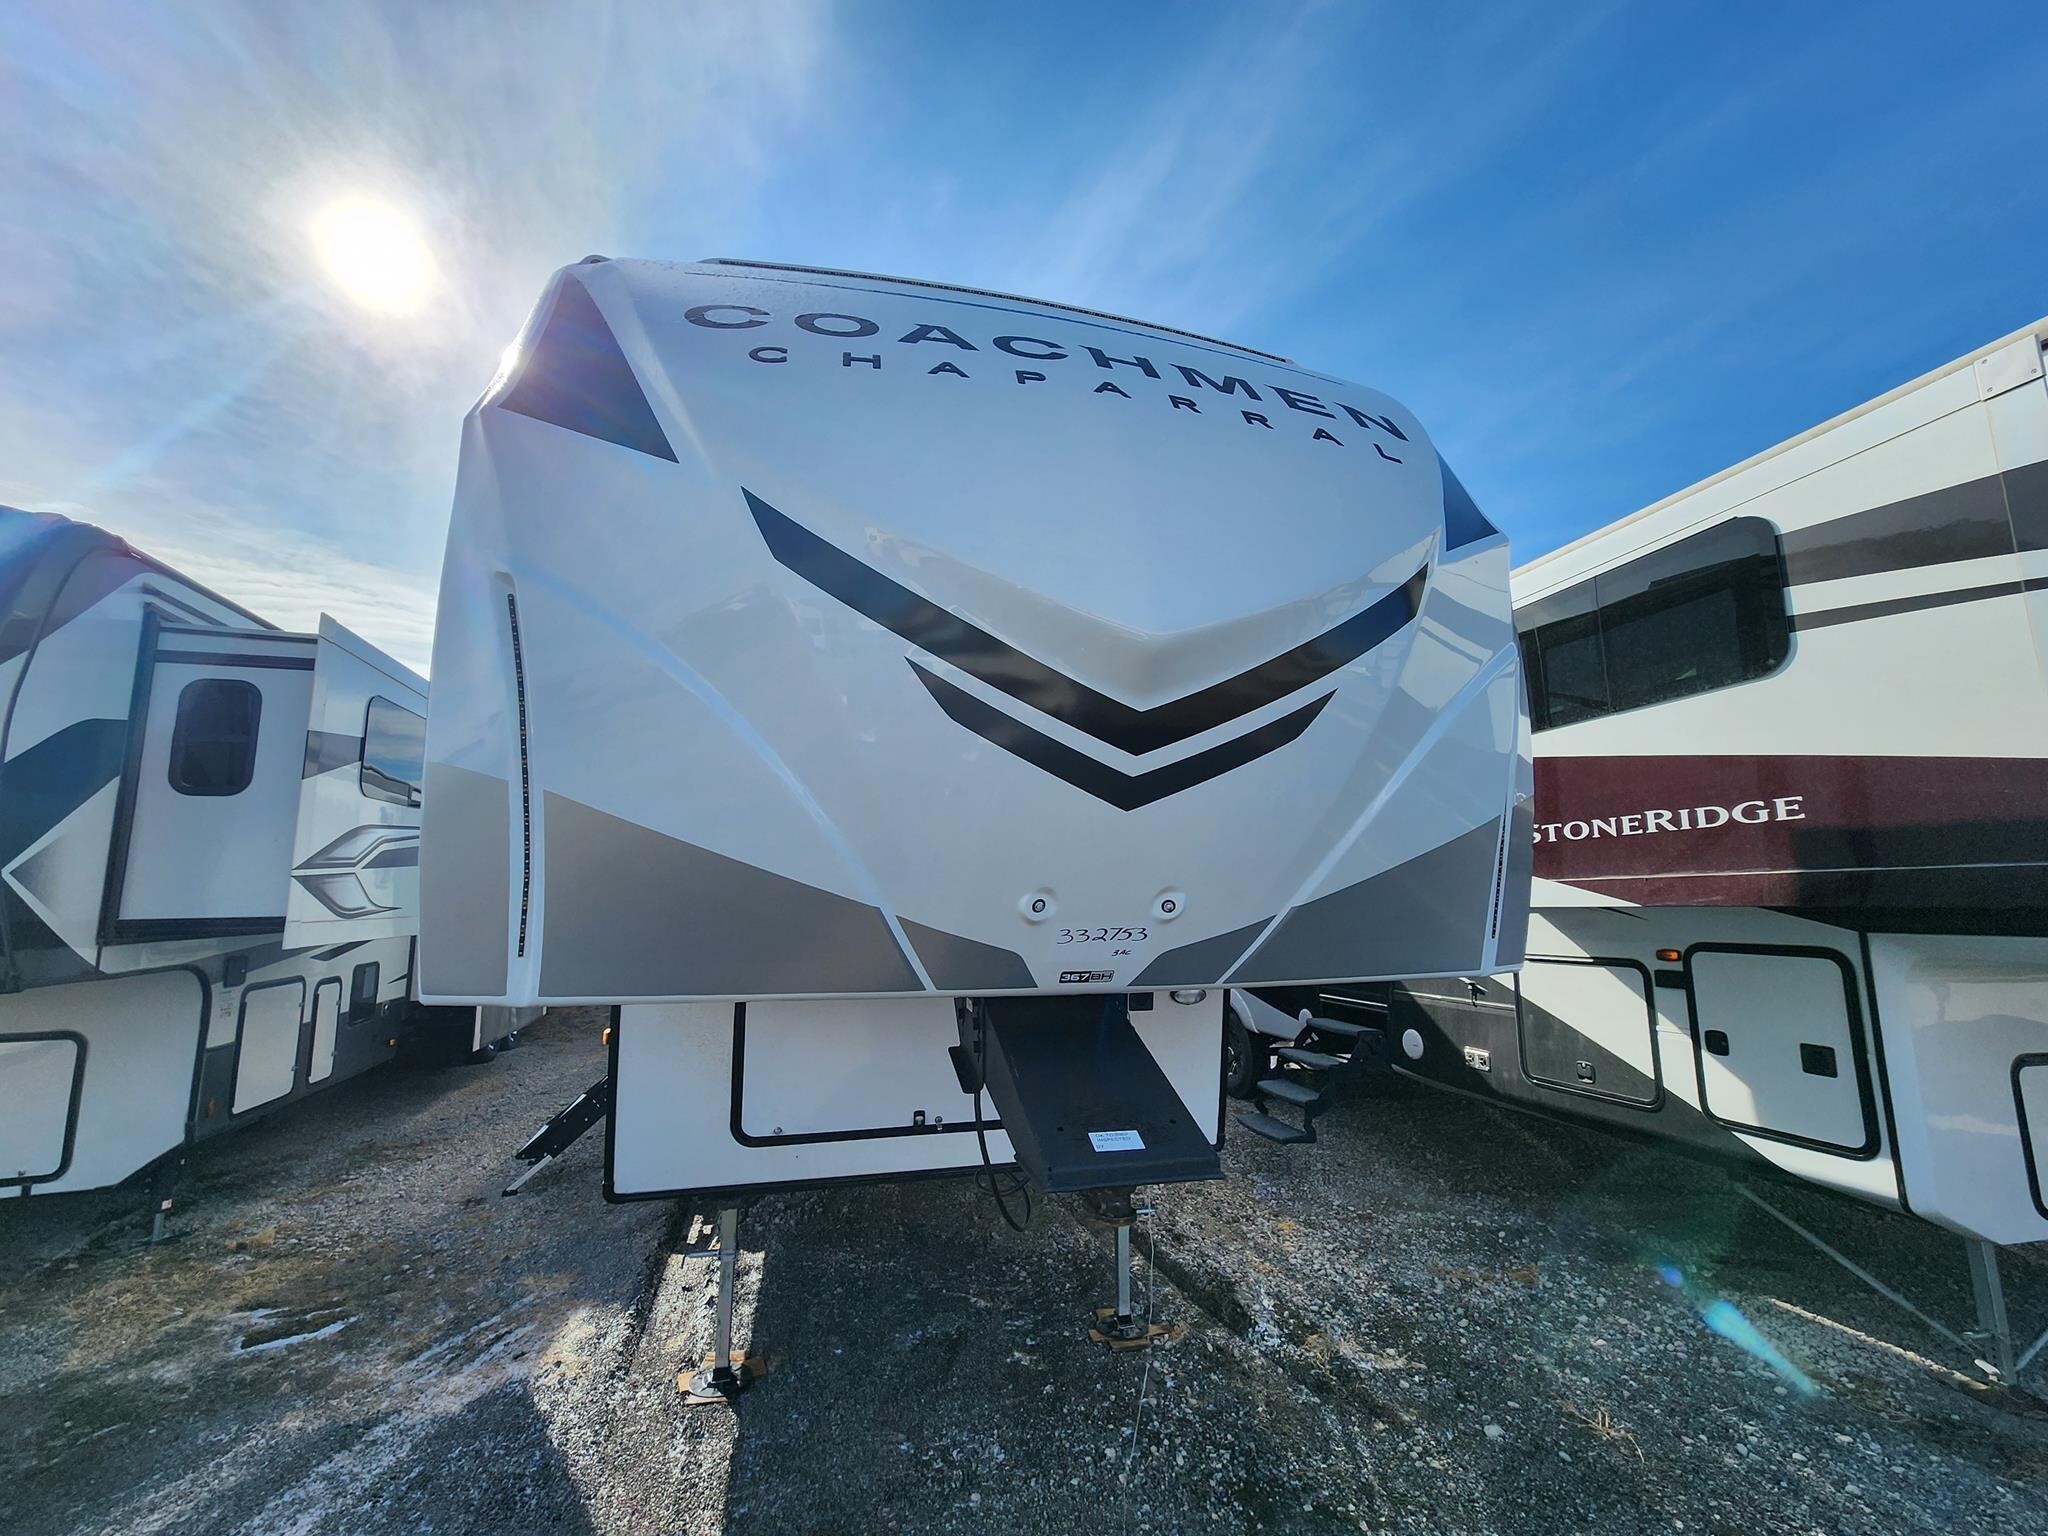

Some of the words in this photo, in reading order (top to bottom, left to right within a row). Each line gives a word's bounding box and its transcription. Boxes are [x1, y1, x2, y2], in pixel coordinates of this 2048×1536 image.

[684, 303, 1409, 442] COACHMEN
[748, 345, 1404, 465] CHAPARRAL
[1533, 796, 1805, 843] STONERIDGE
[1056, 927, 1148, 945] 332753
[1061, 973, 1112, 981] 367BH
